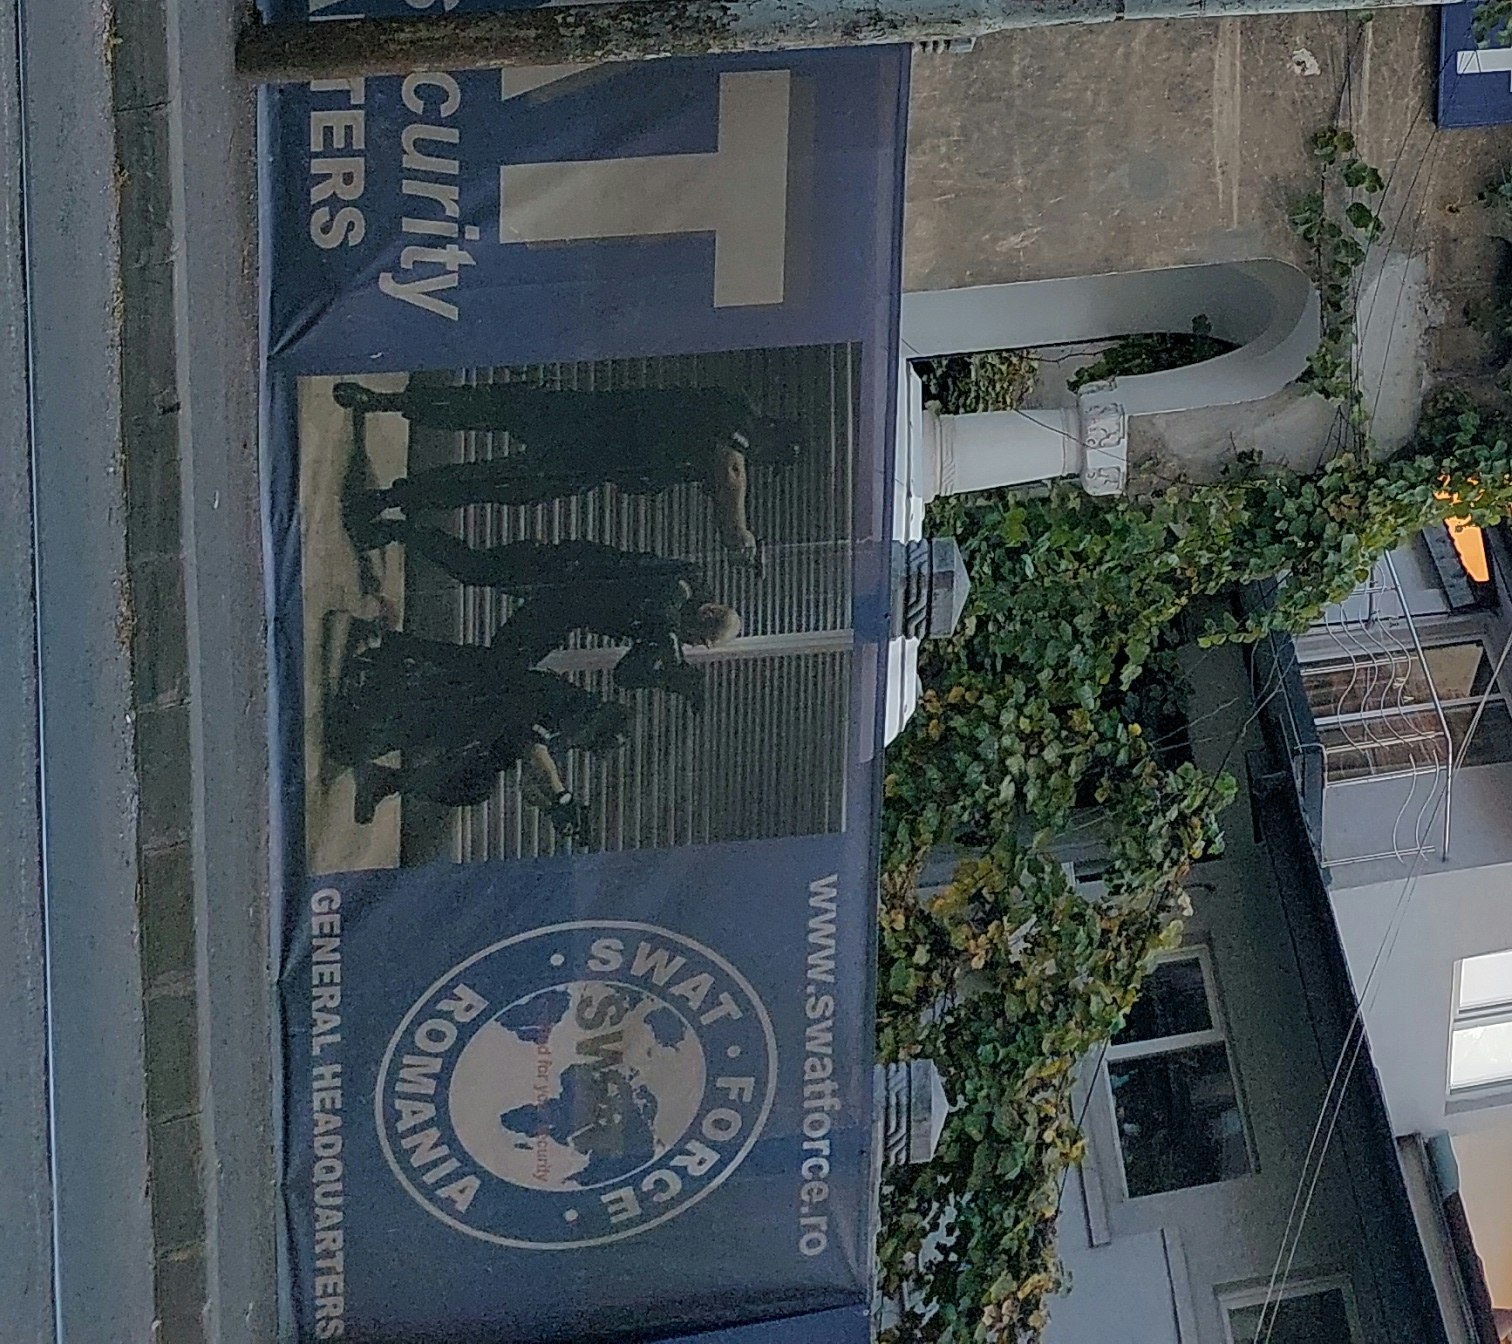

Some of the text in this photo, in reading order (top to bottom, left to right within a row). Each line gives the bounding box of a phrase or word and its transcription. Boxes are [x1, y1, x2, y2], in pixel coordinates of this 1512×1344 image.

[309, 888, 347, 1341] GENERAL HEADQUARTERS
[393, 983, 489, 1214] ROMANIA
[586, 938, 756, 1225] SWAT FORCE
[798, 874, 841, 1257] www.swatforce.ro
